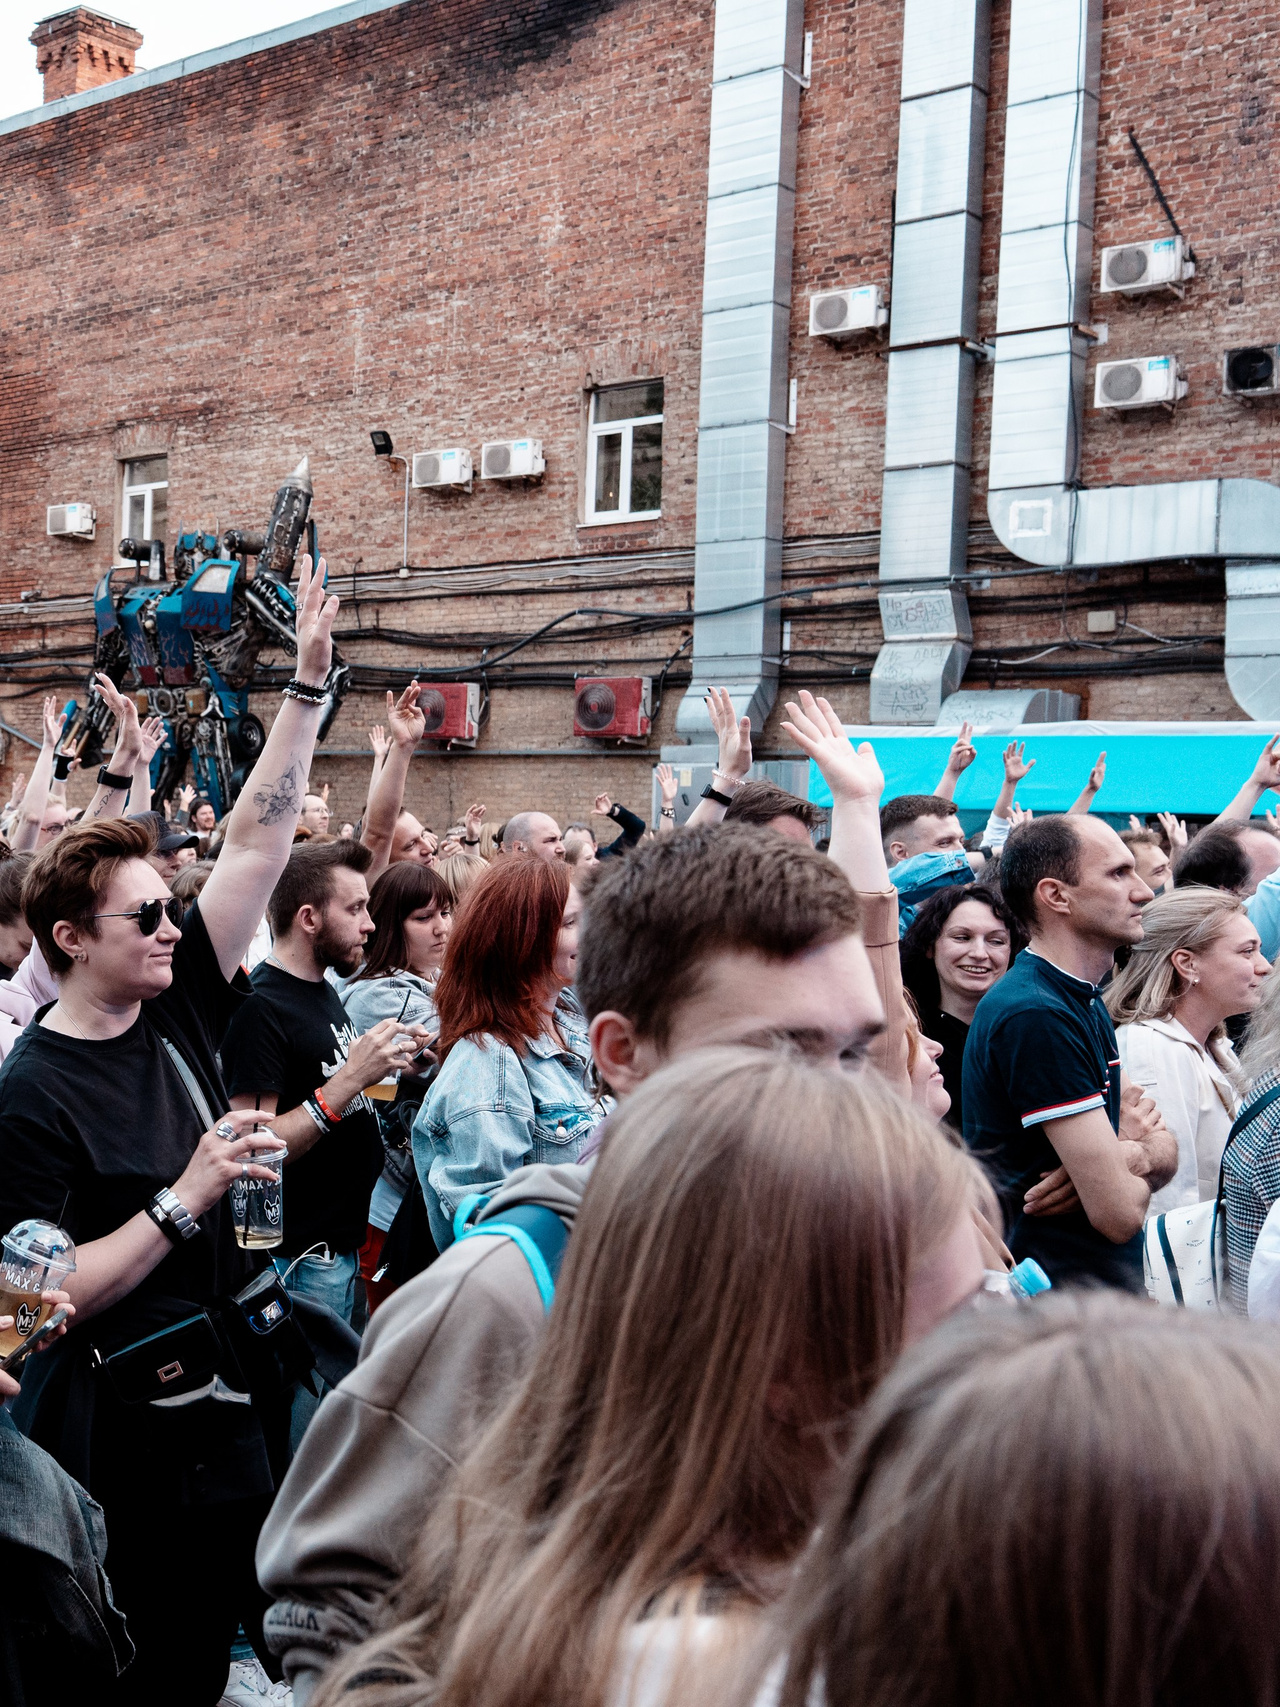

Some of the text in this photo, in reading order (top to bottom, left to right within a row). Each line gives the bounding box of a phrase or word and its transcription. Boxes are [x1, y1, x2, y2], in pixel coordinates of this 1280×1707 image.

[239, 1180, 264, 1191] MAX
[5, 1269, 31, 1291] MAX
[32, 1282, 41, 1293] &
